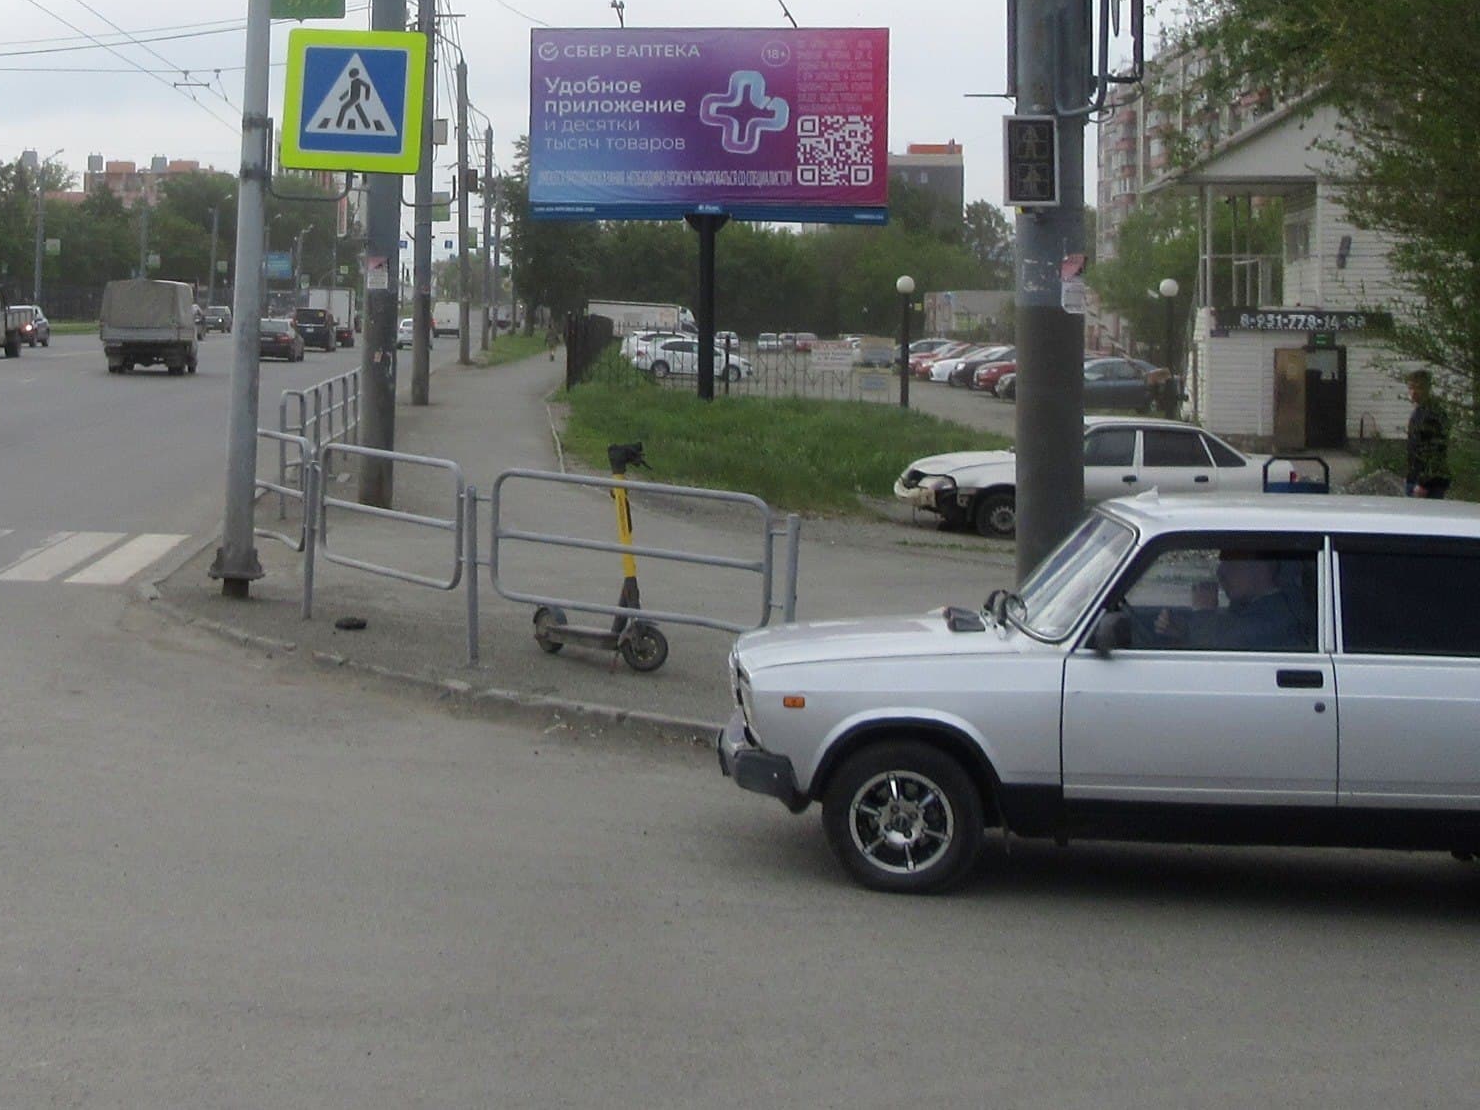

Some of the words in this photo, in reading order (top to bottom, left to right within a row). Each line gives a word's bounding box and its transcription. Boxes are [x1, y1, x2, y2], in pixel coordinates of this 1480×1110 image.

[563, 44, 612, 58] СБЕР
[616, 44, 701, 58] ЕАПТЕКА
[767, 49, 786, 59] 18+
[544, 75, 642, 96] Удобное
[544, 99, 686, 117] приложение
[544, 119, 556, 131] и
[560, 119, 640, 133] десятки
[544, 138, 600, 151] тысяч
[606, 138, 686, 153] товаров
